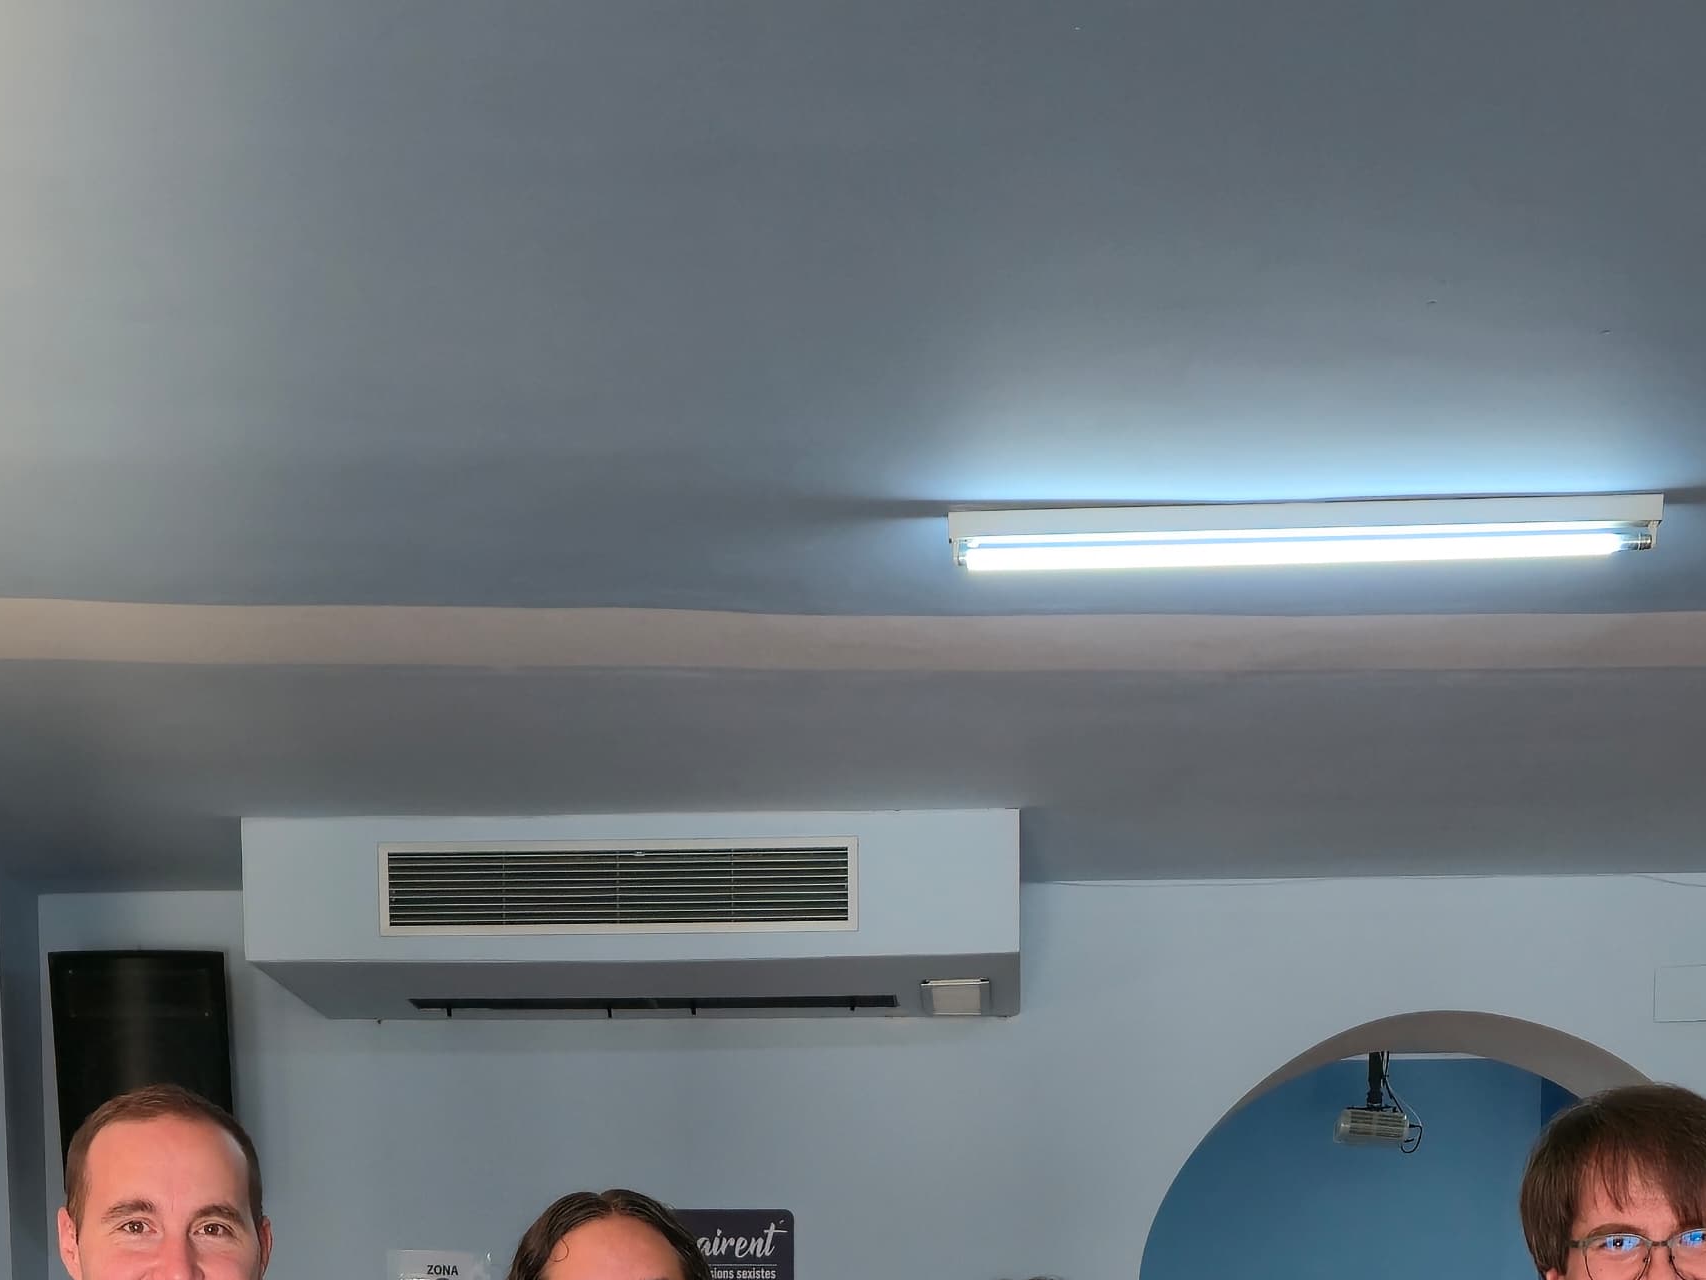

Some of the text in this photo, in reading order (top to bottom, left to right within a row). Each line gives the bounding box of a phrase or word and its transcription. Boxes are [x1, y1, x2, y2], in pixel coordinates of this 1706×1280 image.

[696, 1222, 787, 1258] airent
[427, 1264, 459, 1276] ZONA
[736, 1267, 776, 1279] sexistes
